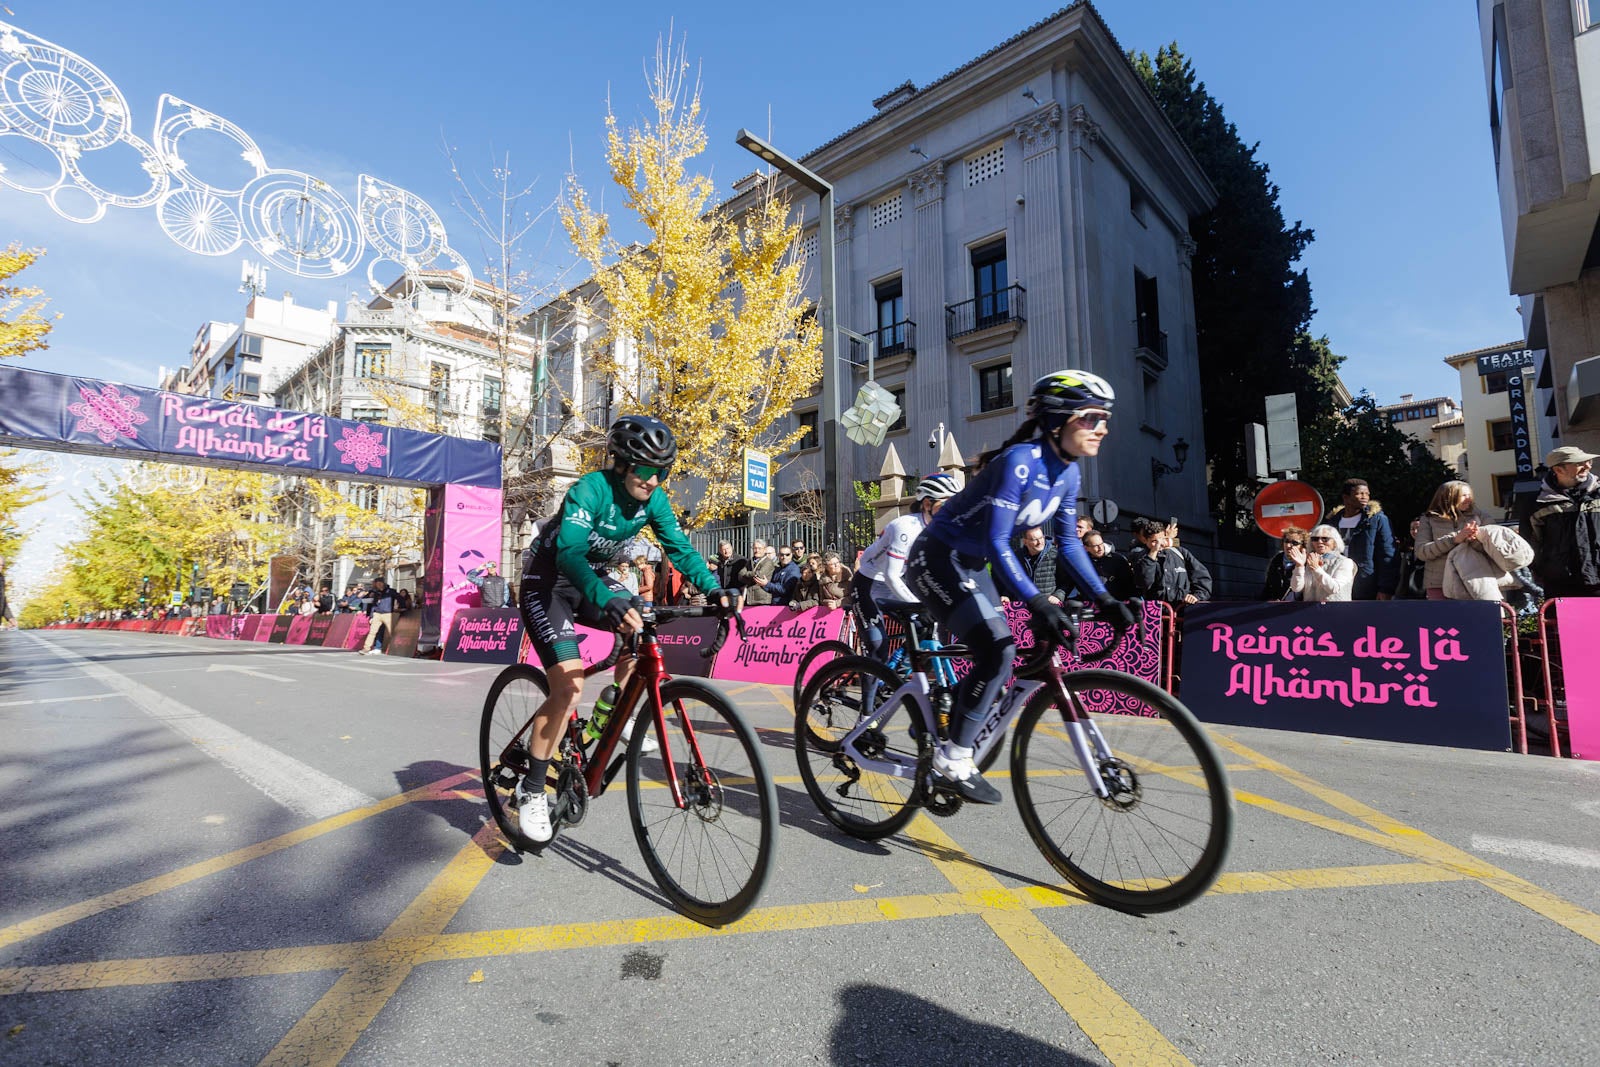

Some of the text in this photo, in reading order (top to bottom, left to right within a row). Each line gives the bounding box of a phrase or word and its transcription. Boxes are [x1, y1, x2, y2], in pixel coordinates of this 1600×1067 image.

[1492, 358, 1534, 369] MUSICAL
[1509, 376, 1531, 472] GRANADA 10
[750, 478, 765, 489] TAXI
[656, 634, 702, 645] RELEVO
[972, 686, 1026, 757] RBEA
